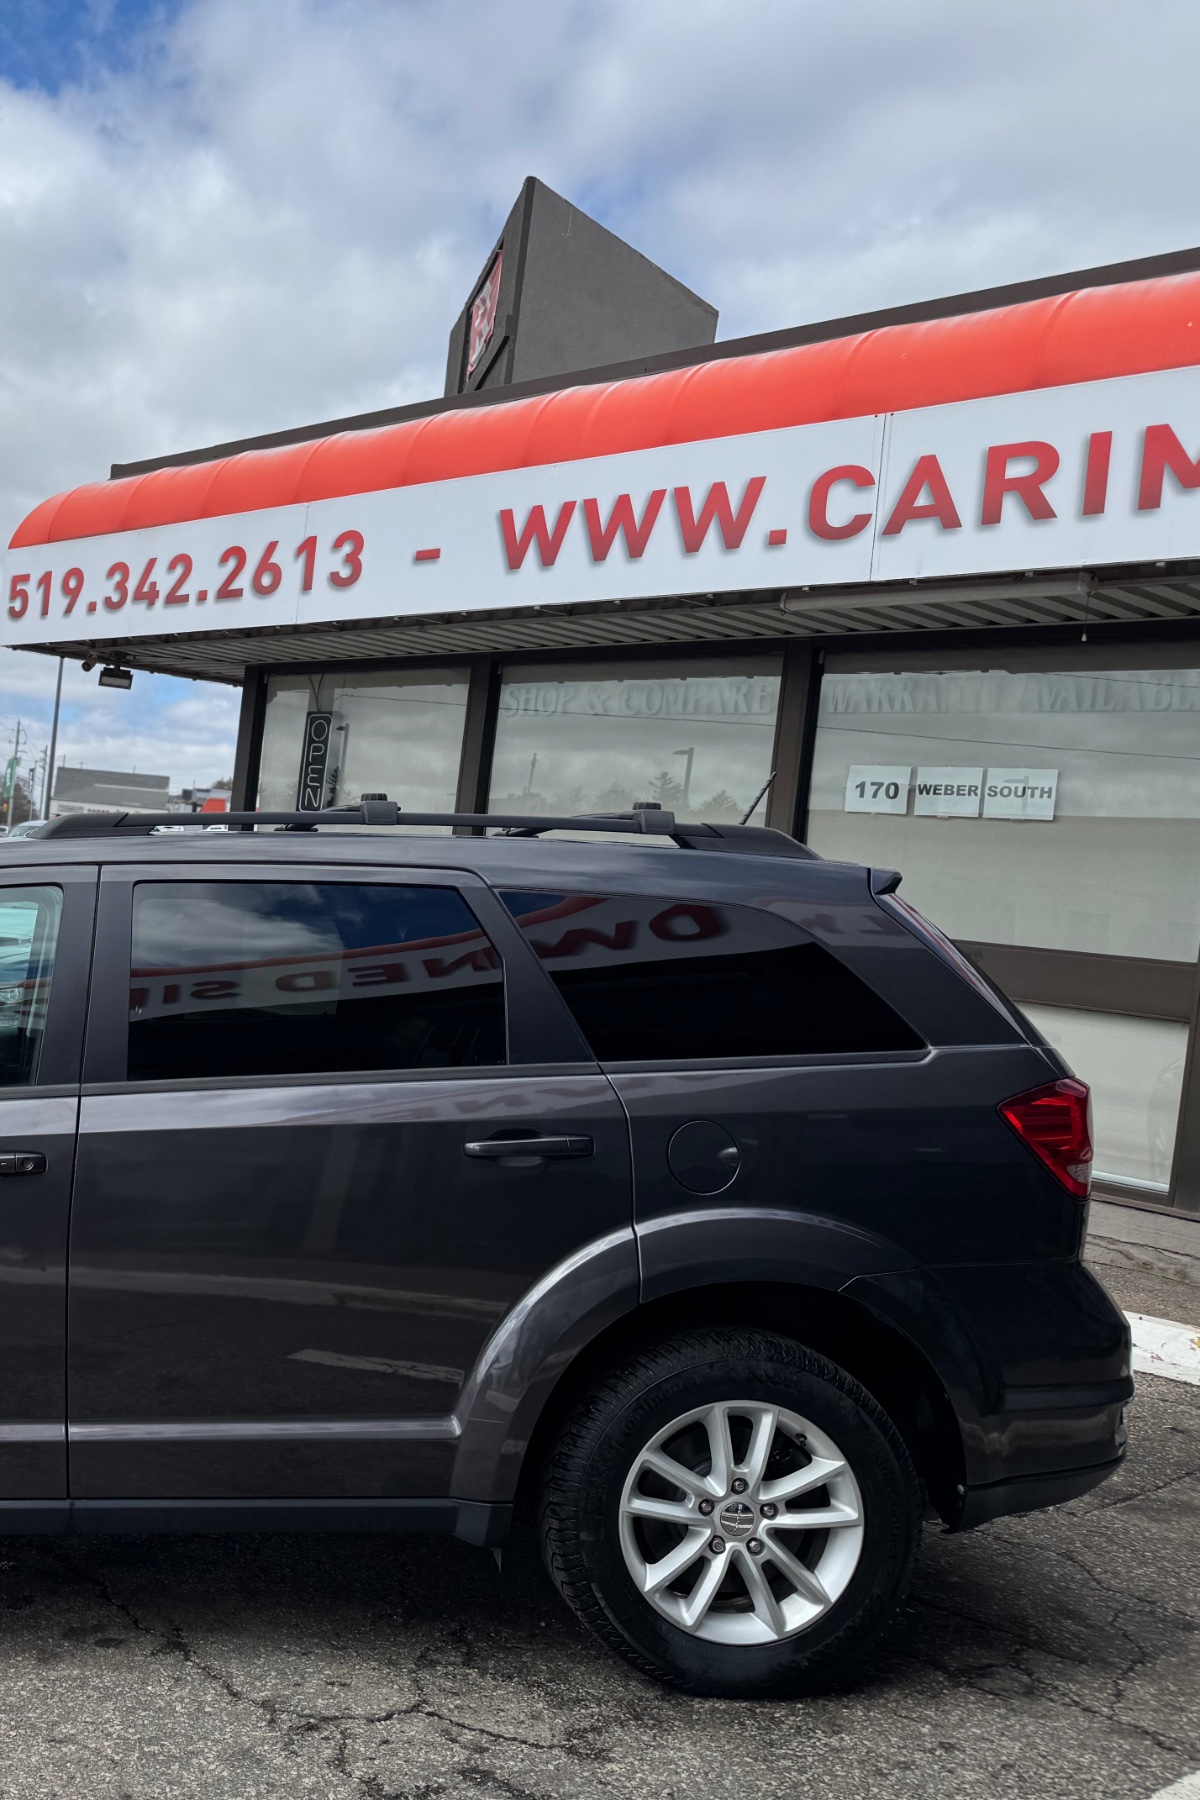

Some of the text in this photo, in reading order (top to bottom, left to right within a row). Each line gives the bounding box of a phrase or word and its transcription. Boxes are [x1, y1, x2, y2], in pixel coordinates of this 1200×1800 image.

[8, 529, 364, 619] 519.342.2613
[502, 686, 575, 716] SHOP
[618, 680, 776, 715] COMPARE
[305, 720, 328, 807] OPEN
[855, 781, 1052, 799] 170 WEBER SOUTH
